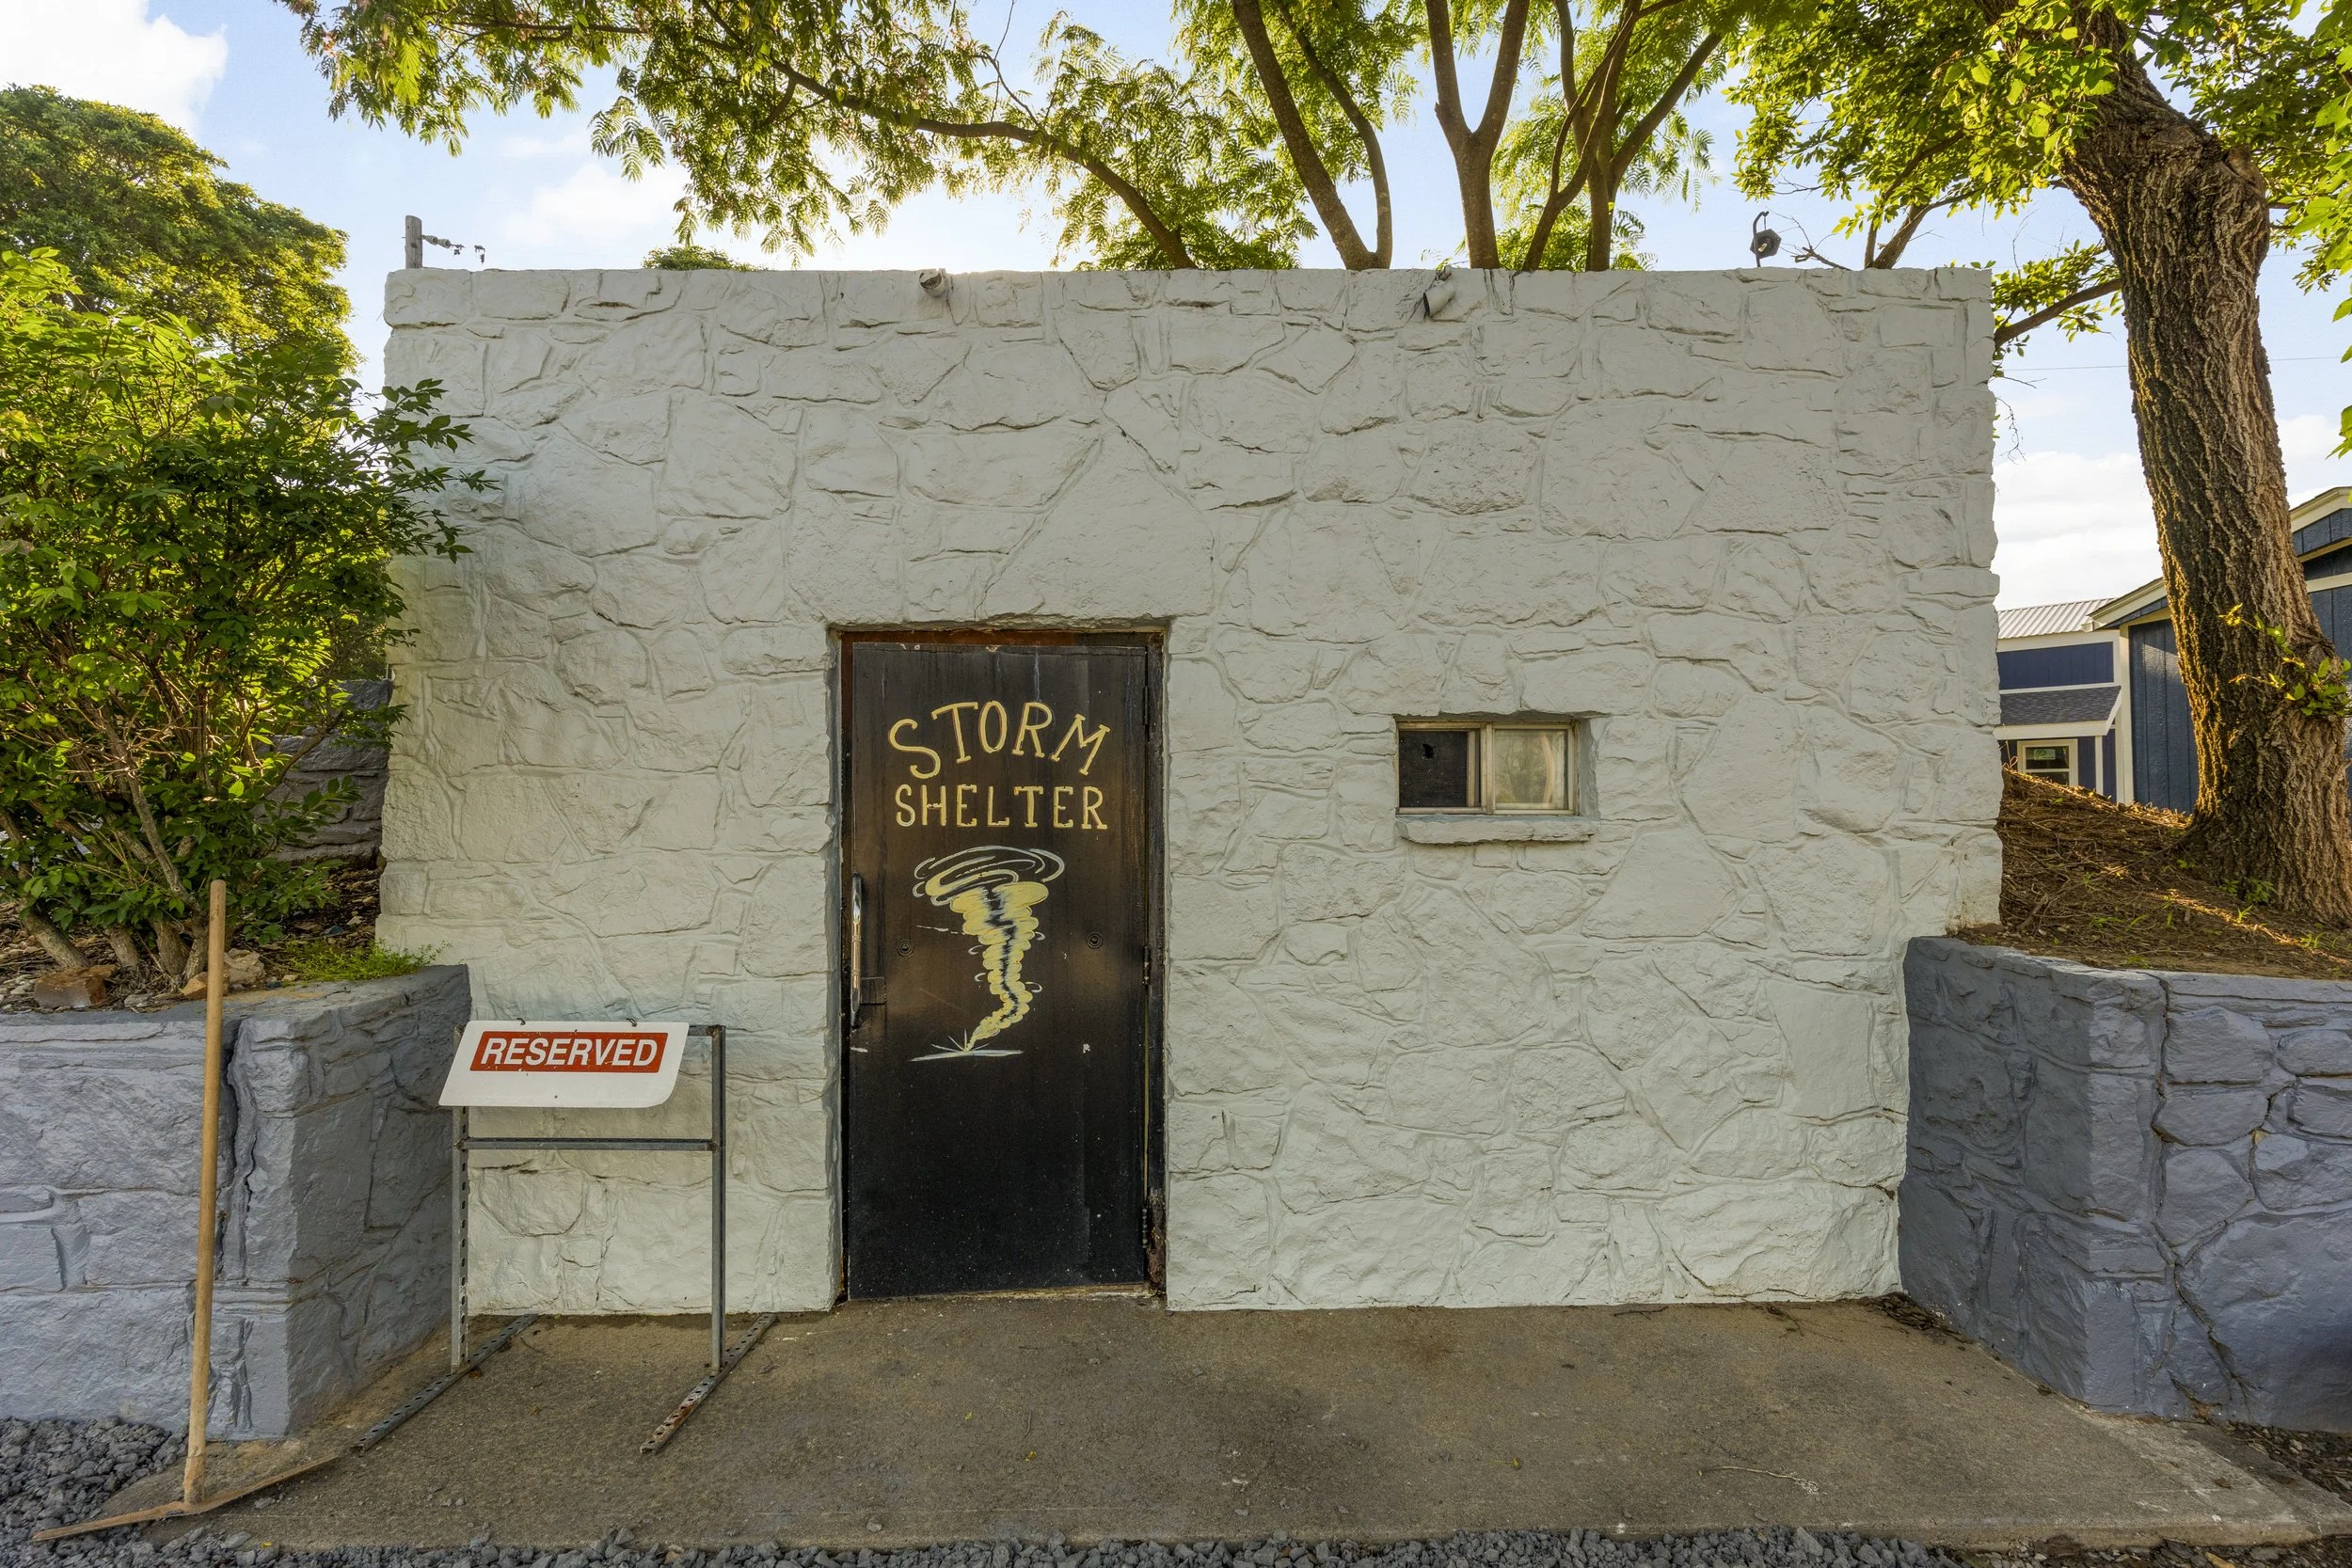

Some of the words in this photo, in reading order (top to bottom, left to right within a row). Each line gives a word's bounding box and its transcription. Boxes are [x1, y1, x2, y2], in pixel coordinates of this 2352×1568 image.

[888, 700, 1111, 780] STORM
[895, 784, 1108, 830] SHELTER
[481, 1037, 659, 1066] RESERVED
